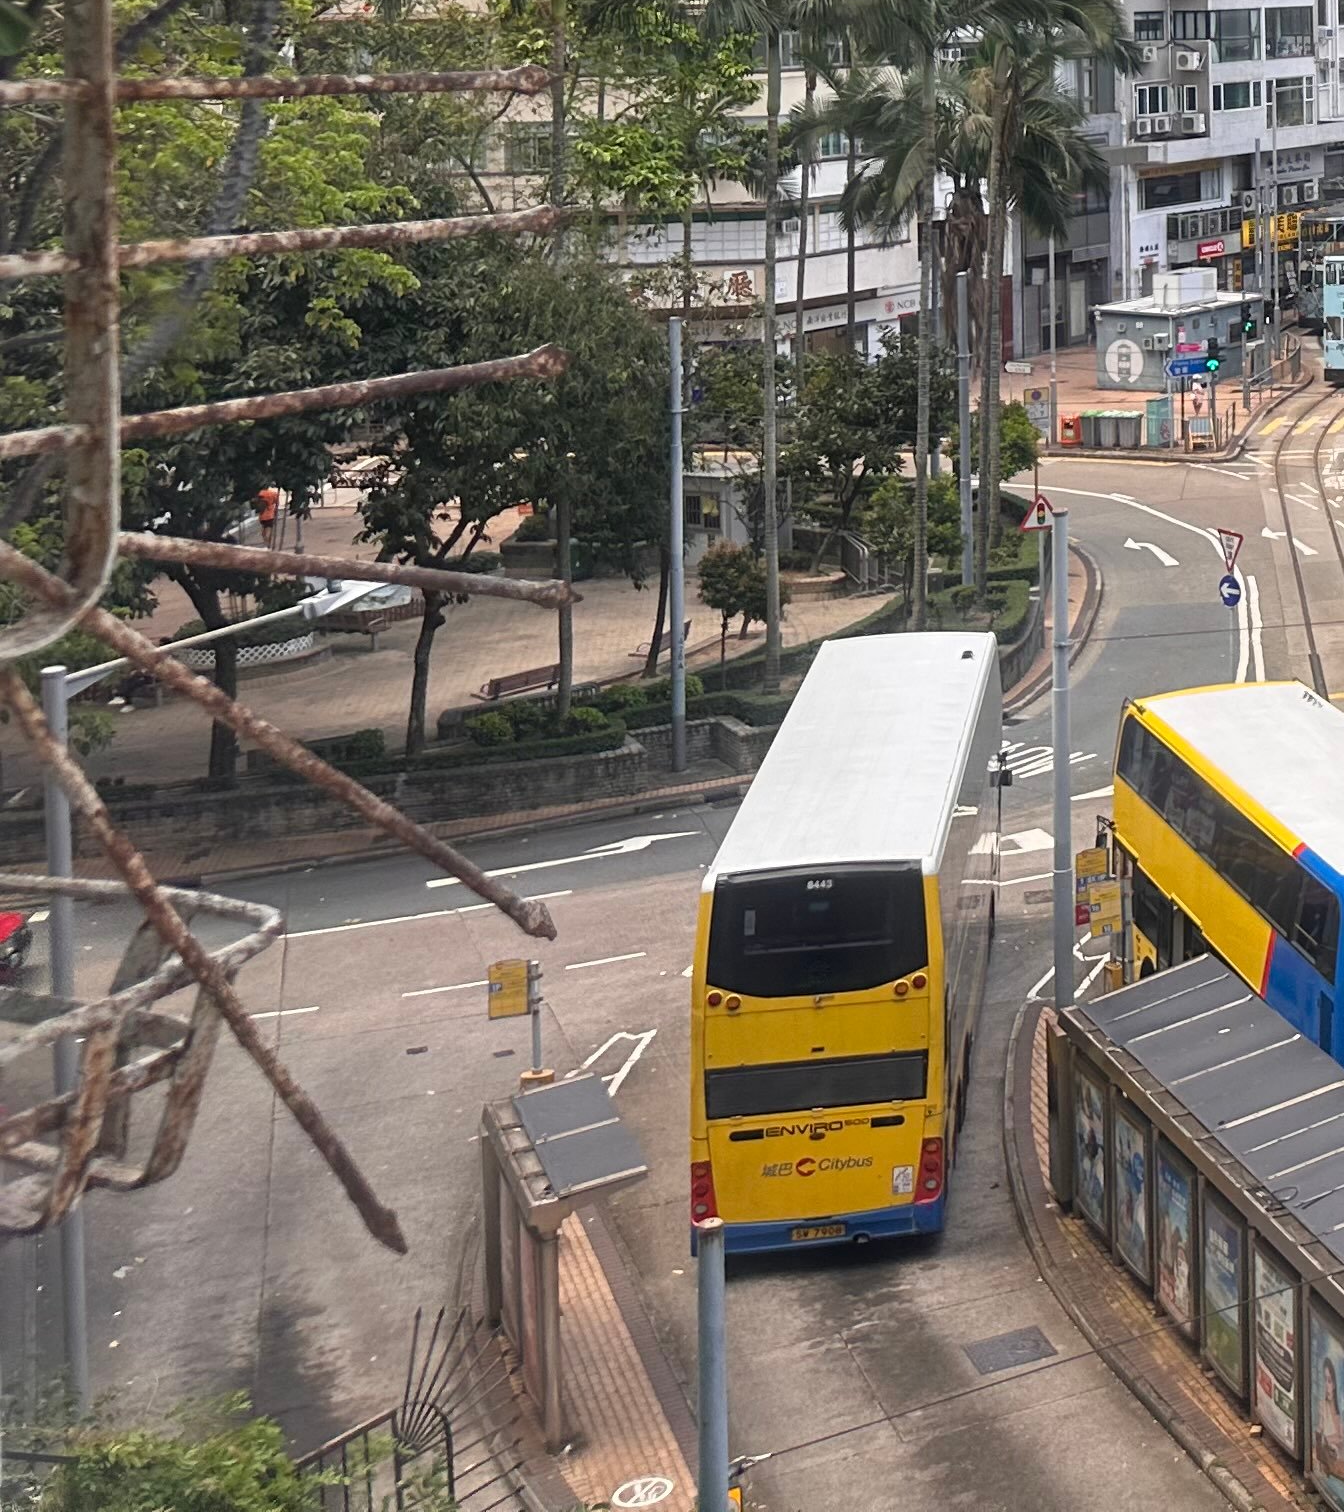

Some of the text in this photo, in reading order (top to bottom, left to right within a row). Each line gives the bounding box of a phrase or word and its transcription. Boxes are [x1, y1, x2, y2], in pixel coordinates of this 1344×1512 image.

[807, 878, 833, 890] 8443
[762, 1163, 792, 1177] 城巴
[819, 1156, 873, 1172] Citybus
